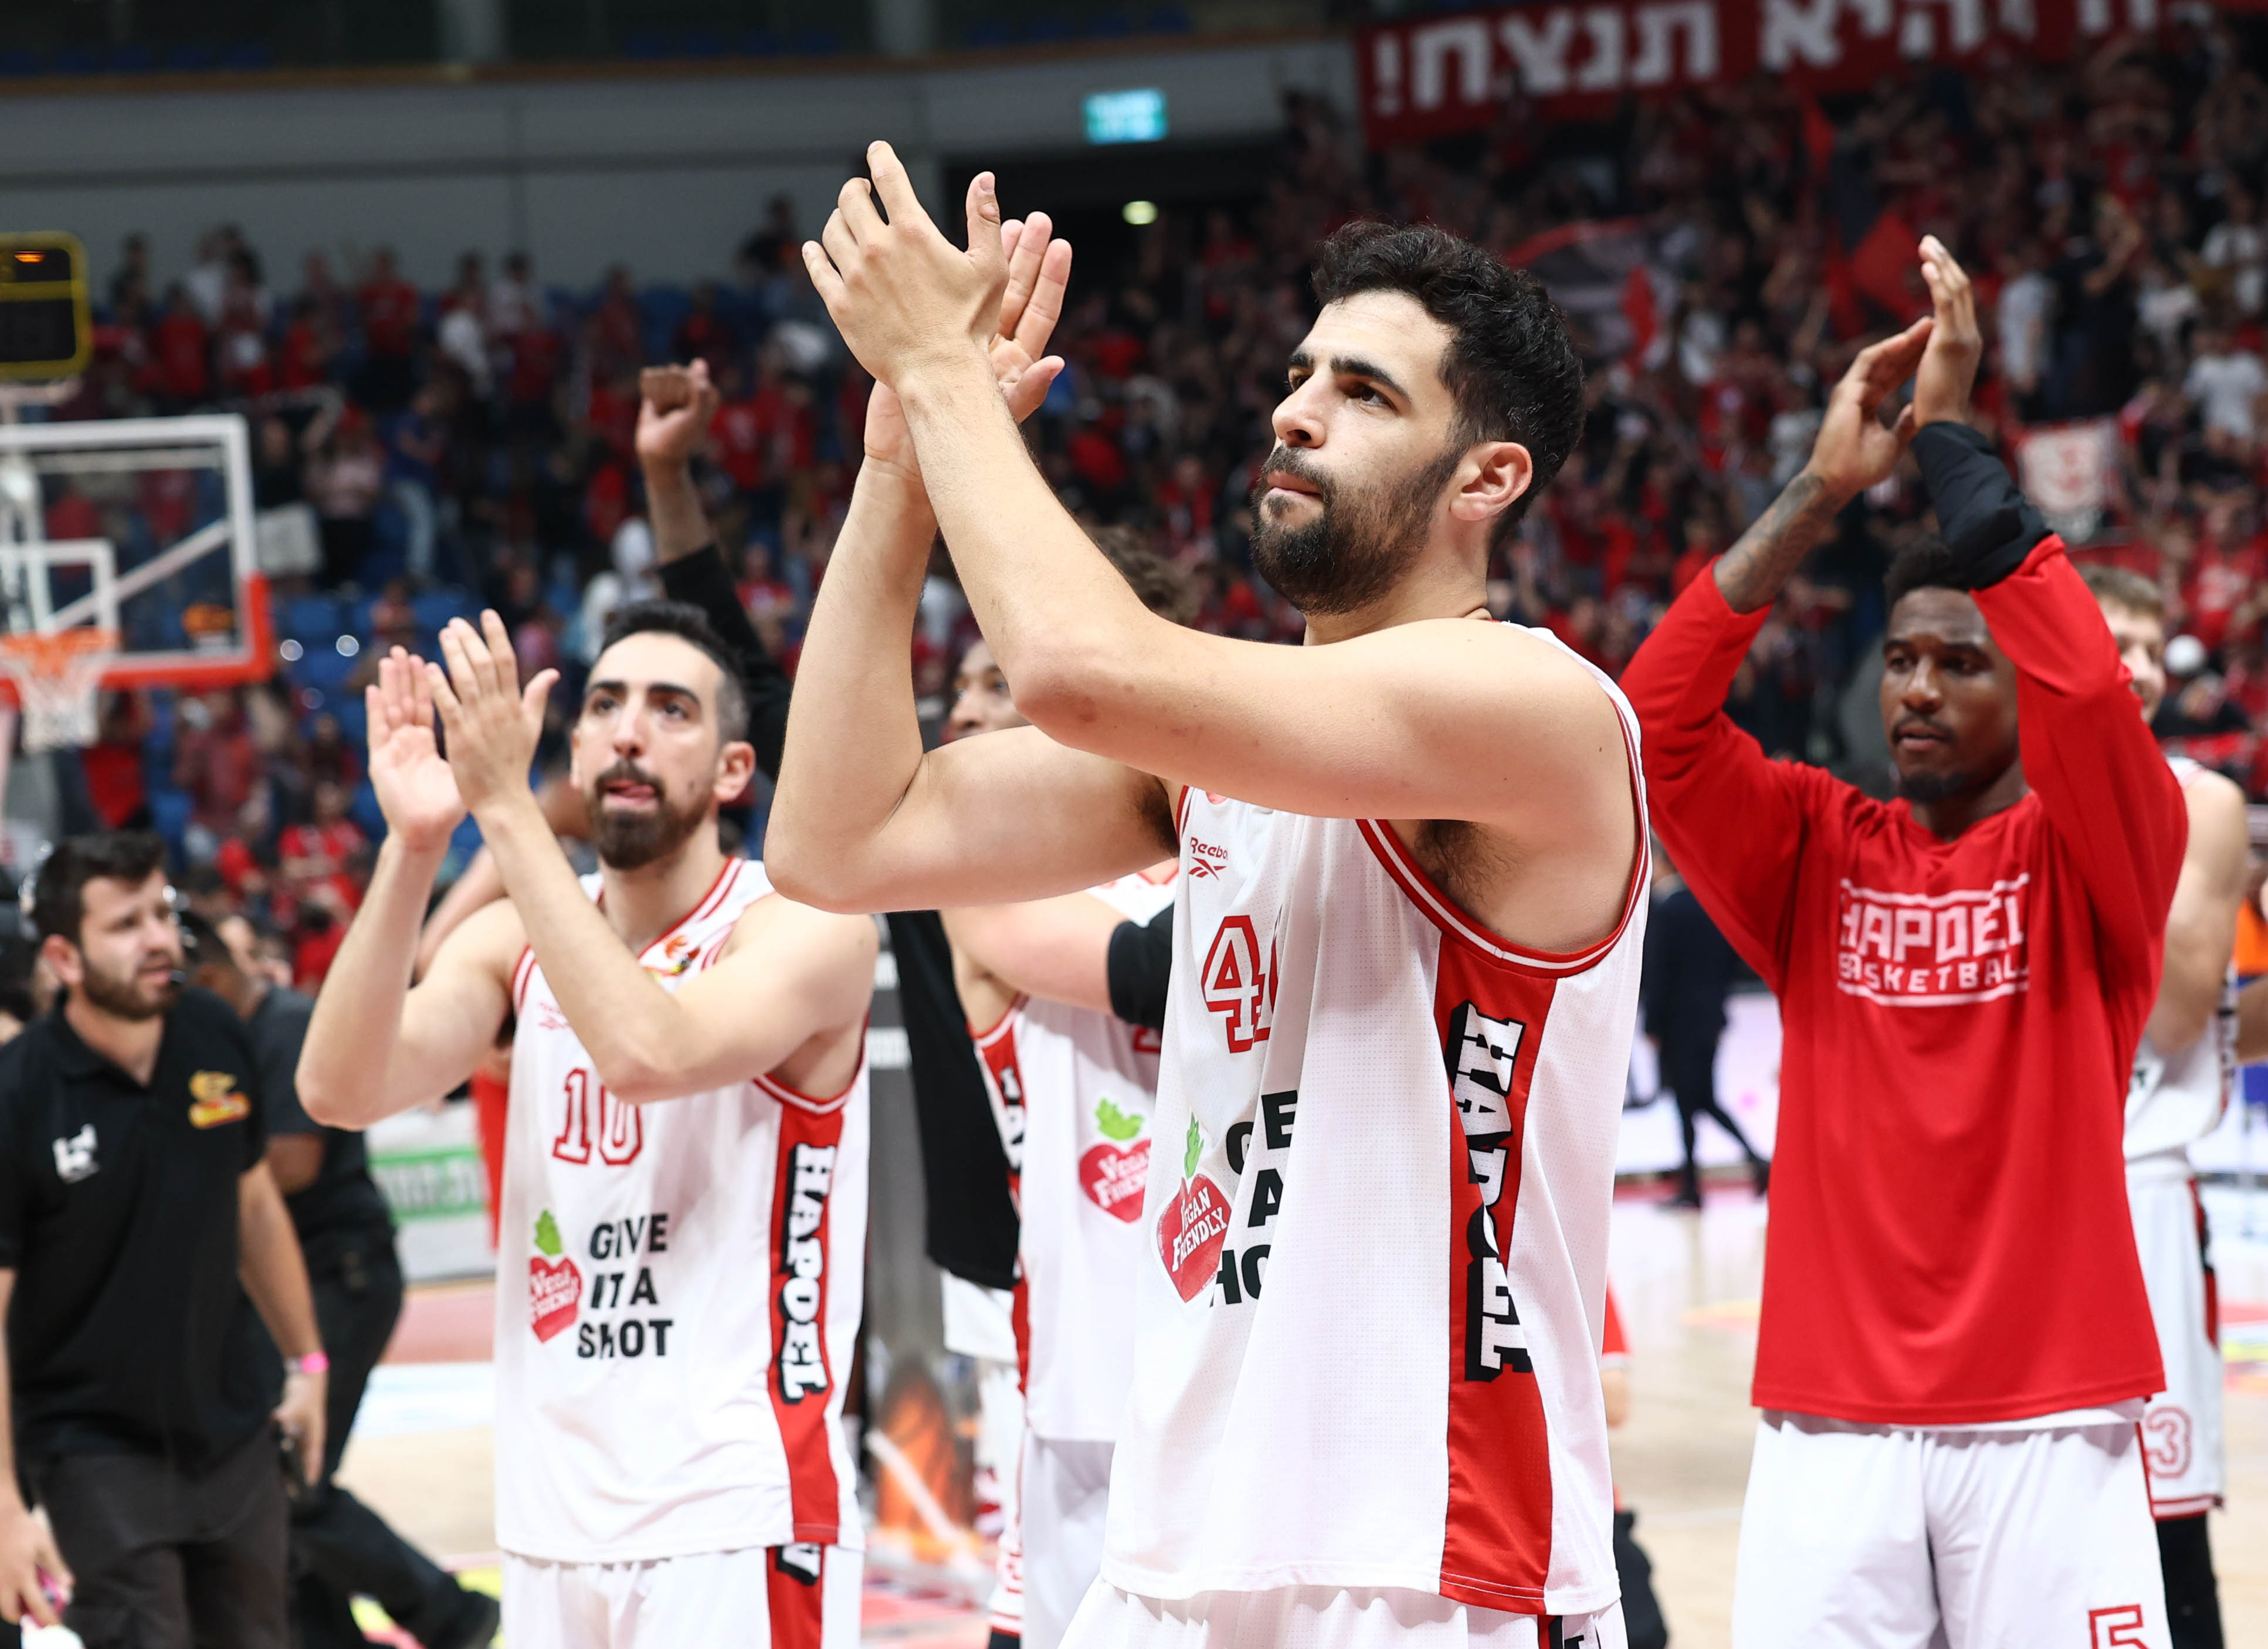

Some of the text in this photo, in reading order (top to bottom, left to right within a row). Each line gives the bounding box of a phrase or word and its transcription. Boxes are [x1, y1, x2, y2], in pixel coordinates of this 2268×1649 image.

[1371, 0, 1718, 116] תנצח!
[1190, 836, 1228, 861] Reebo
[1201, 906, 1283, 1054] 4
[552, 1068, 643, 1166] 10
[590, 1213, 668, 1260] GIVE
[1172, 1206, 1228, 1273] FRIENDLY
[590, 1267, 659, 1309] IT A
[779, 1142, 837, 1403] HAPOEL
[577, 1319, 673, 1359] SHOT
